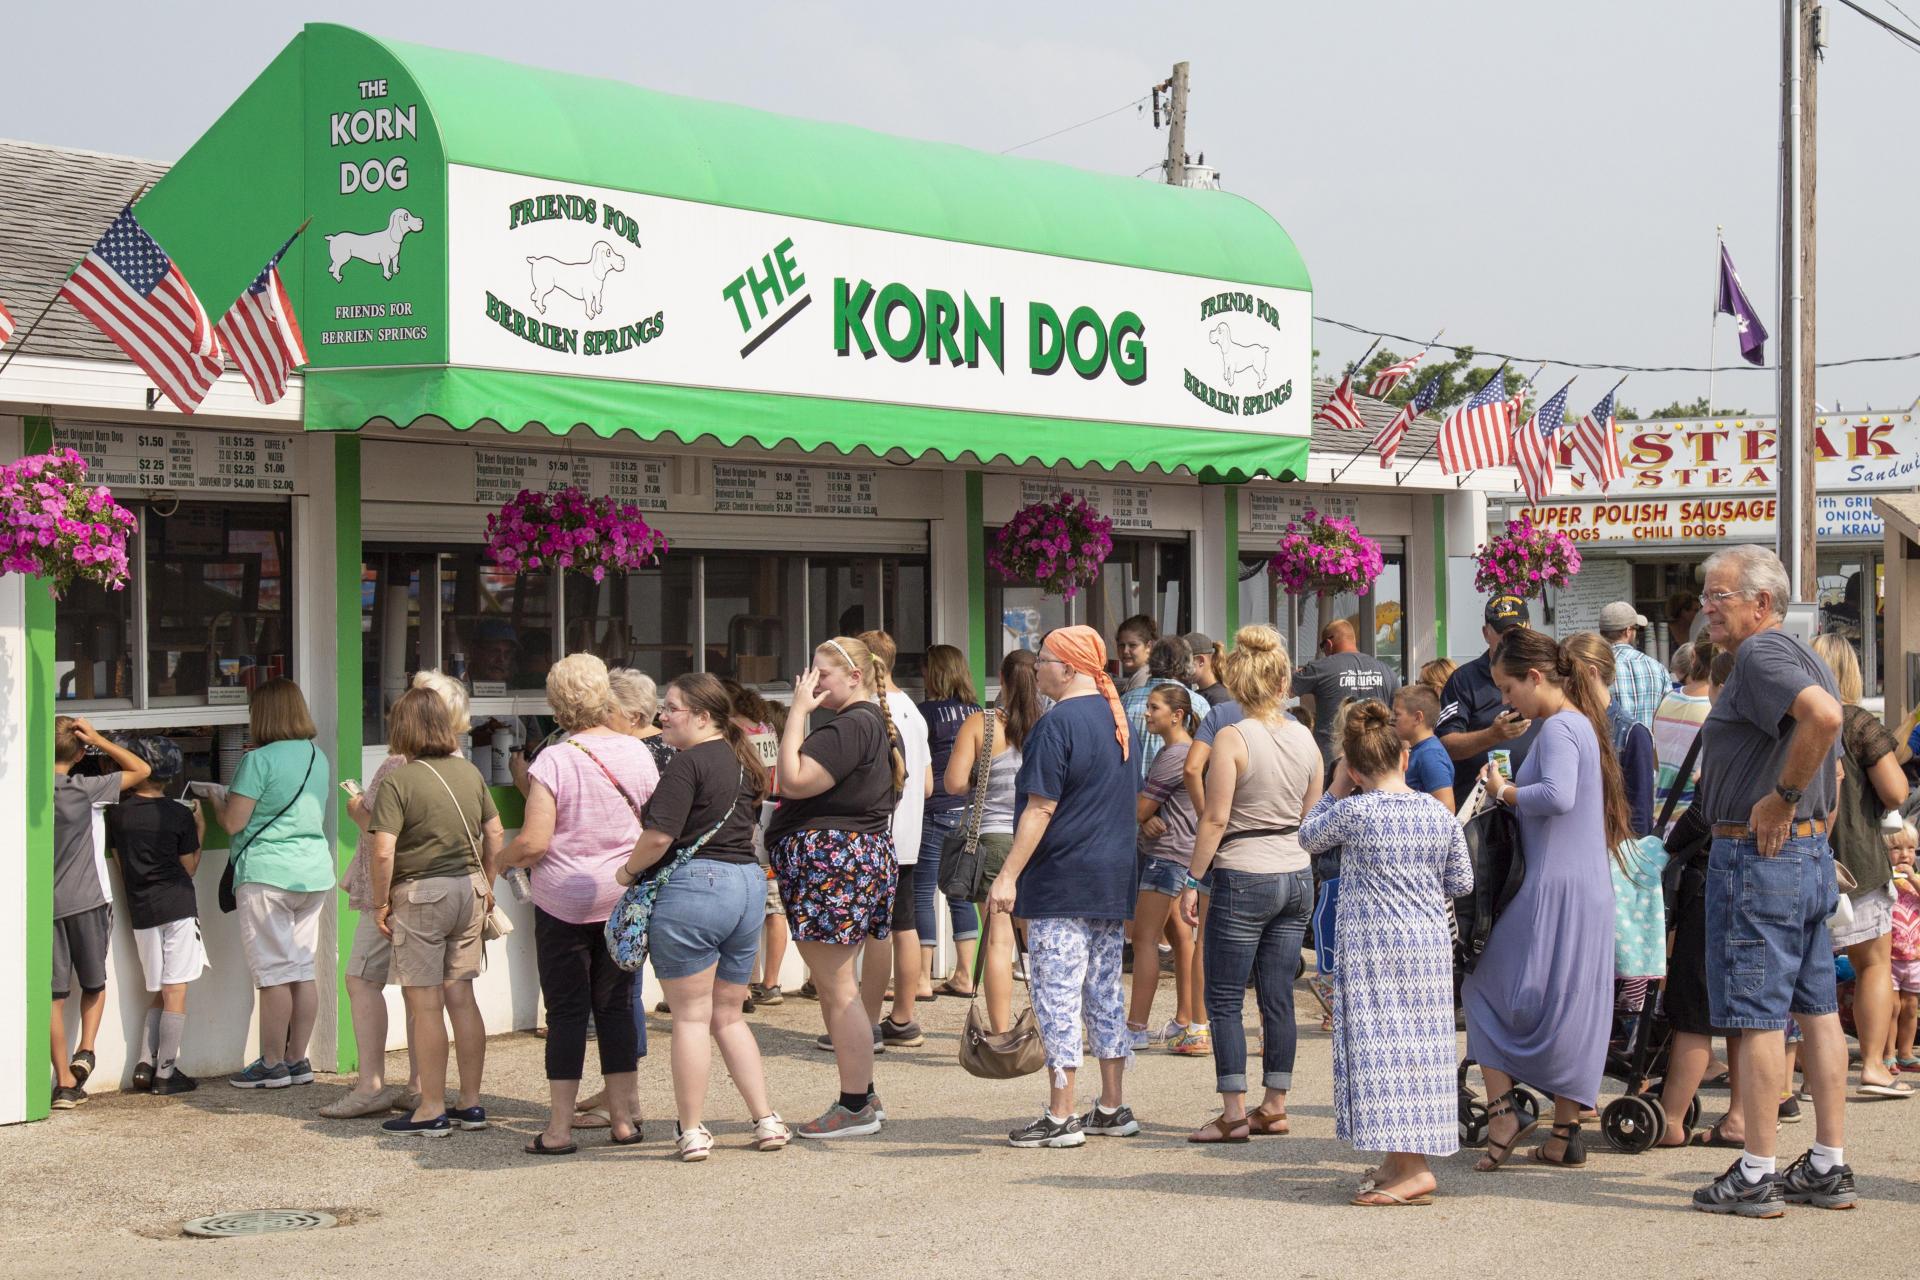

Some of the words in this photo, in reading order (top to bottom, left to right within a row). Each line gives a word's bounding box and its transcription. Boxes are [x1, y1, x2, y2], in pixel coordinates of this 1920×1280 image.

[358, 79, 388, 100] THE
[330, 103, 417, 147] KORN
[340, 155, 408, 195] DOG
[509, 194, 597, 230] FRIENDS
[602, 203, 642, 248] FOR
[721, 236, 807, 334] THE
[335, 304, 386, 320] FRIENDS
[389, 301, 413, 316] FOR
[1201, 292, 1254, 321] FRIENDS
[1256, 298, 1281, 331] FOR
[485, 290, 578, 355] BERRIEN
[583, 311, 665, 356] SPRINGS
[321, 329, 374, 345] BERRIEN
[377, 325, 428, 343] SPRINGS
[833, 276, 1005, 375] KORN
[1028, 300, 1147, 386] DOG
[1184, 367, 1240, 416] BERRIEN
[1243, 379, 1293, 416] SPRINGS
[70, 430, 95, 441] Original
[96, 430, 110, 441] Korn
[111, 431, 123, 443] Dog
[138, 435, 164, 447] $1.50
[233, 436, 254, 447] $1.25
[79, 441, 94, 452] Korn
[95, 443, 107, 454] Dog
[91, 456, 104, 468] Dog
[233, 450, 255, 461] $1.50
[233, 464, 255, 475] $2.25
[264, 463, 285, 473] $1.00
[548, 461, 569, 471] $1.50
[621, 462, 637, 470] $1.25
[1847, 452, 1920, 482] Sandwi
[139, 473, 165, 485] $1.50
[621, 474, 638, 483] $1.50
[1634, 465, 1772, 489] STEA
[233, 478, 255, 489] $4.00
[273, 479, 294, 490] $2.00
[621, 486, 637, 495] $2.25
[776, 492, 793, 500] $2.25
[1818, 497, 1837, 508] ith
[776, 503, 793, 512] $1.50
[1593, 503, 1668, 525] POLISH
[1680, 499, 1776, 522] SAUSAGE
[1632, 525, 1673, 540] CHILI
[1682, 523, 1726, 538] DOGS
[1817, 526, 1833, 536] or
[1842, 523, 1884, 536] KRAU
[1339, 676, 1357, 687] CAR
[1357, 675, 1383, 687] WASH
